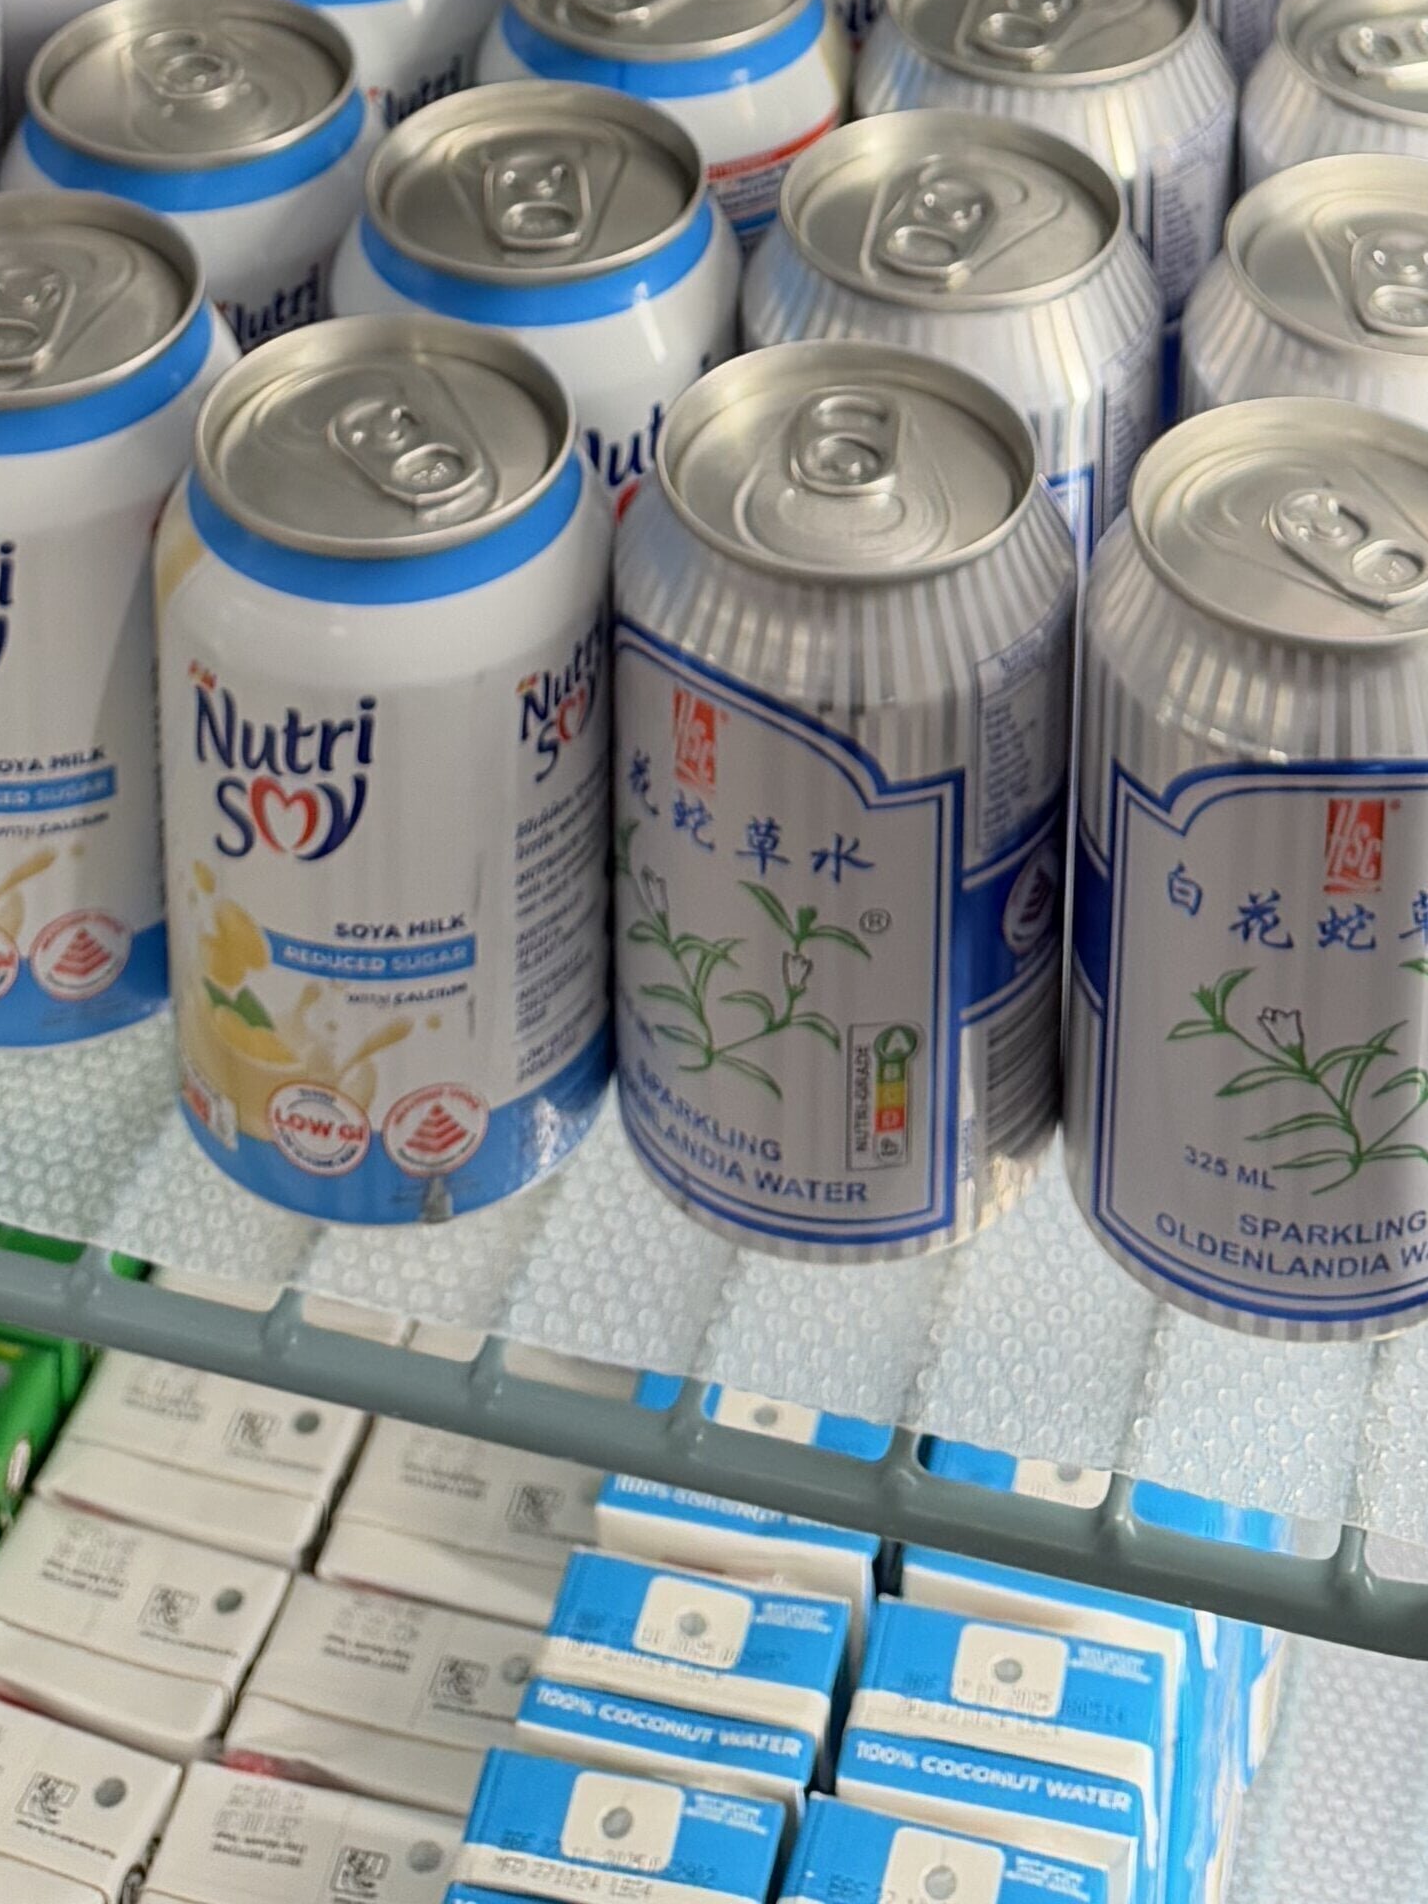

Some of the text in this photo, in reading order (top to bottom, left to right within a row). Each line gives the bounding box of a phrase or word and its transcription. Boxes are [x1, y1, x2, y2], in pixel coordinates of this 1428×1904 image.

[194, 694, 378, 776] Nutri
[334, 913, 468, 941] SOYA MILK
[283, 944, 469, 973] REDUCED SUGAR
[273, 1107, 333, 1139] LOW
[753, 1168, 869, 1205] WATER
[1183, 1144, 1279, 1192] 325 ML
[1154, 1212, 1391, 1279] OLDENLANDIA
[1238, 1208, 1428, 1246] SPARKLING
[534, 1686, 803, 1759] 100% COCONUT WATER
[855, 1739, 1133, 1814] 100% COCONUT WATER
